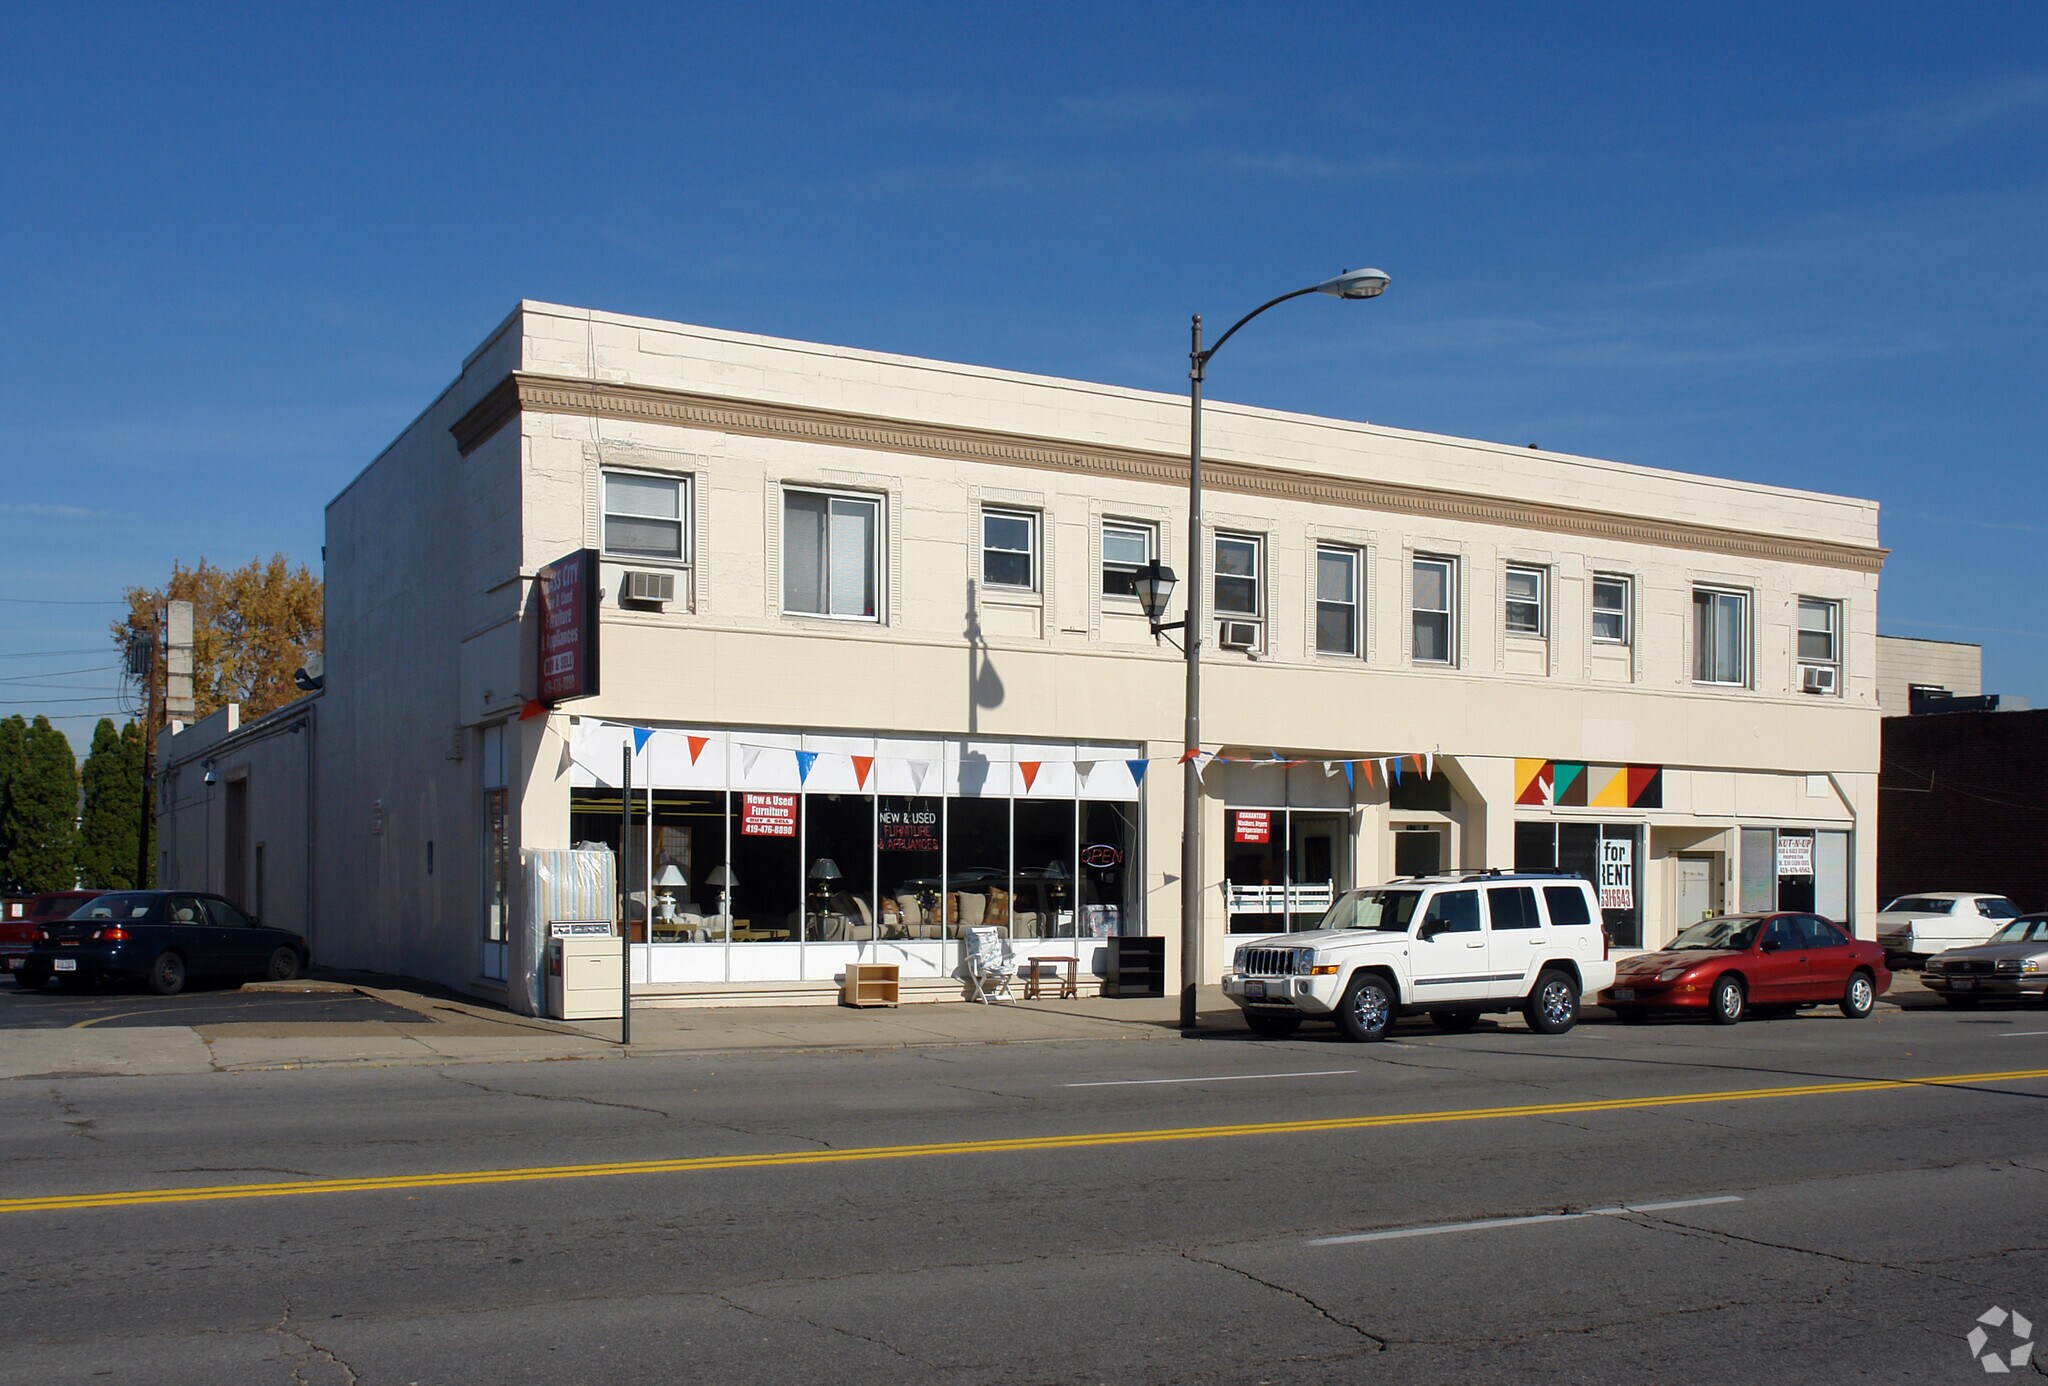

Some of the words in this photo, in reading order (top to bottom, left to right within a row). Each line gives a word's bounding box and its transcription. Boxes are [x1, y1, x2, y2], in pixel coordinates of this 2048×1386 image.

[562, 562, 579, 588] CITY
[560, 651, 573, 670] SELL
[747, 794, 765, 804] New
[765, 796, 772, 805] &
[773, 795, 793, 806] Used
[751, 805, 789, 817] Furniture
[879, 812, 900, 824] NEW
[903, 812, 910, 824] &
[912, 812, 936, 824] USED
[745, 824, 793, 834] 419-476-8890
[884, 825, 931, 837] FURNITURE
[888, 838, 939, 850] APPLIANCES
[1778, 839, 1811, 847] KUT-N-UP
[1081, 849, 1124, 863] OPEN
[1604, 841, 1625, 861] for
